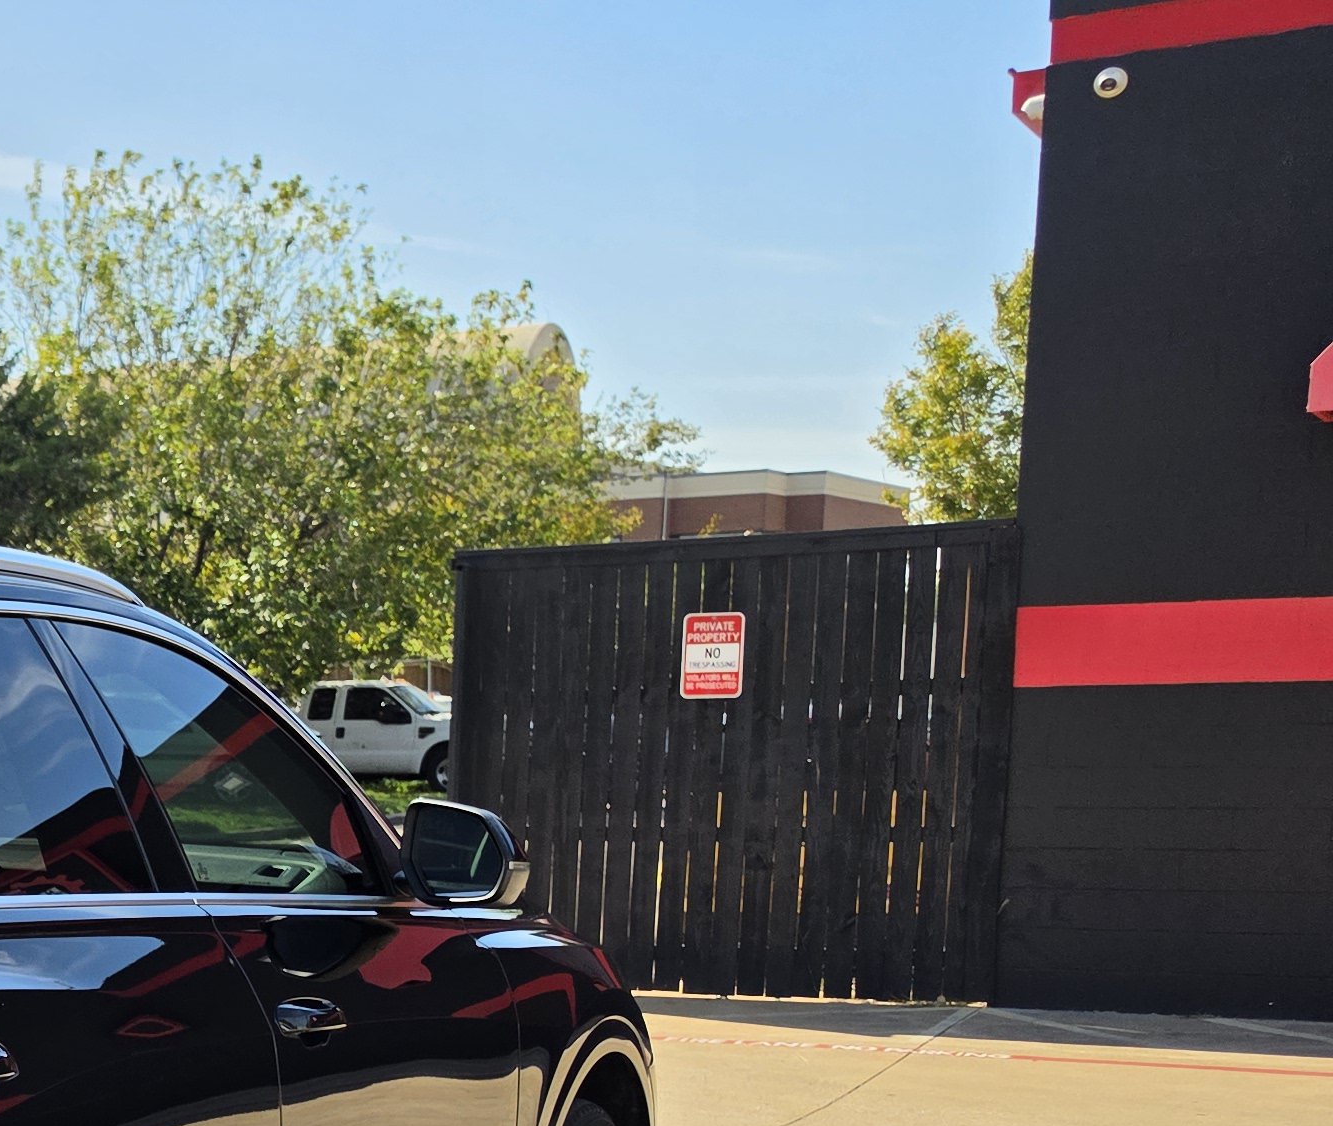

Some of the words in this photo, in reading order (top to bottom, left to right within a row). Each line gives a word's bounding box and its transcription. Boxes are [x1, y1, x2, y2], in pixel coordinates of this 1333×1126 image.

[693, 621, 735, 632] PRIVATE
[687, 632, 740, 643] PROPERTY
[705, 647, 721, 659] NO
[689, 660, 736, 669] TRESPASSING
[664, 1035, 724, 1045] FIRE
[734, 1038, 815, 1048] LANE
[831, 1043, 878, 1051] NO
[884, 1046, 1012, 1059] PARKING
